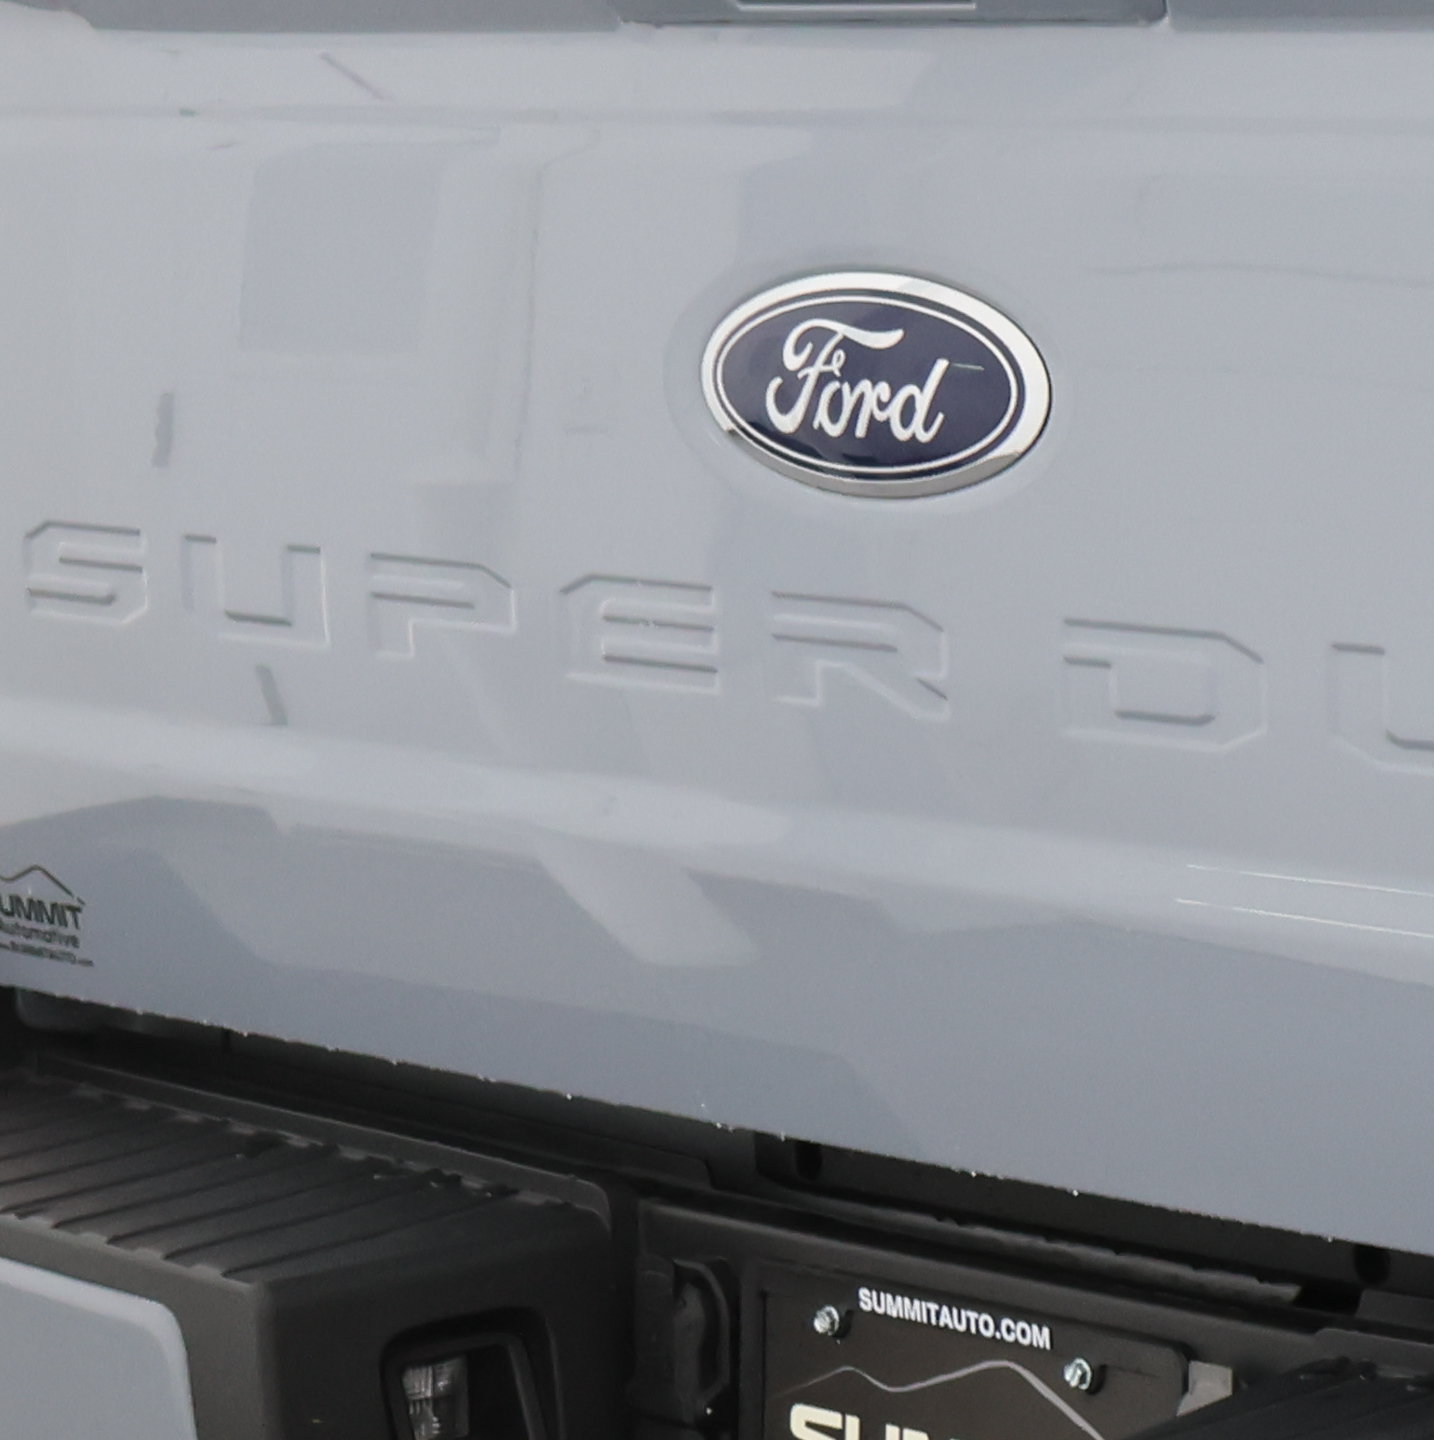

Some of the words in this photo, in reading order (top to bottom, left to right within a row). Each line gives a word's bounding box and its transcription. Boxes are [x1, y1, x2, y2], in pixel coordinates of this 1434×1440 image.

[765, 318, 950, 443] Ford
[25, 520, 950, 720] SUPER
[858, 1287, 1051, 1351] SUMMITAUTO.COM
